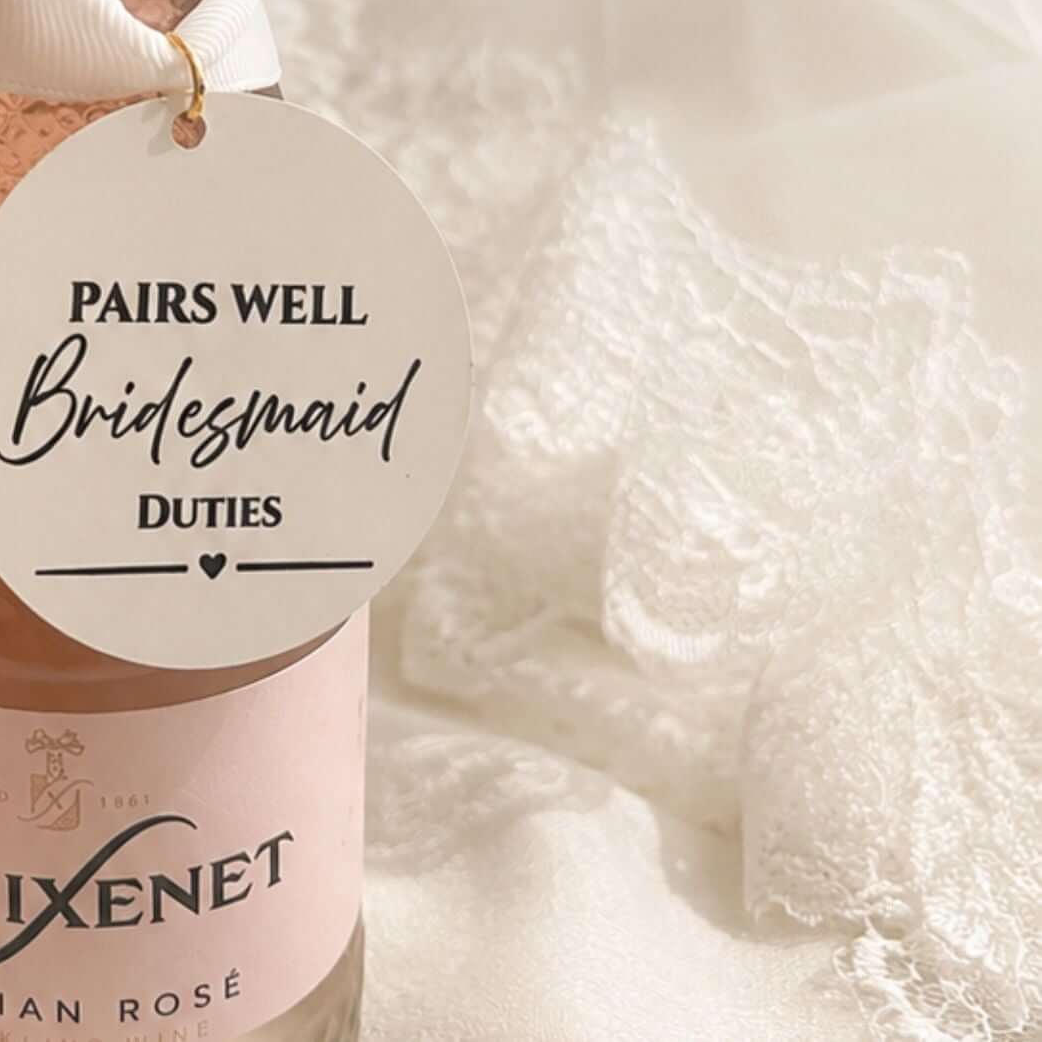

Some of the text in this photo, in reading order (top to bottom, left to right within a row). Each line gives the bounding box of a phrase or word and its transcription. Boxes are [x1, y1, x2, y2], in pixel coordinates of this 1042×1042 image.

[69, 280, 369, 326] PAIRS WELL
[119, 968, 242, 1023] ROSÉ
